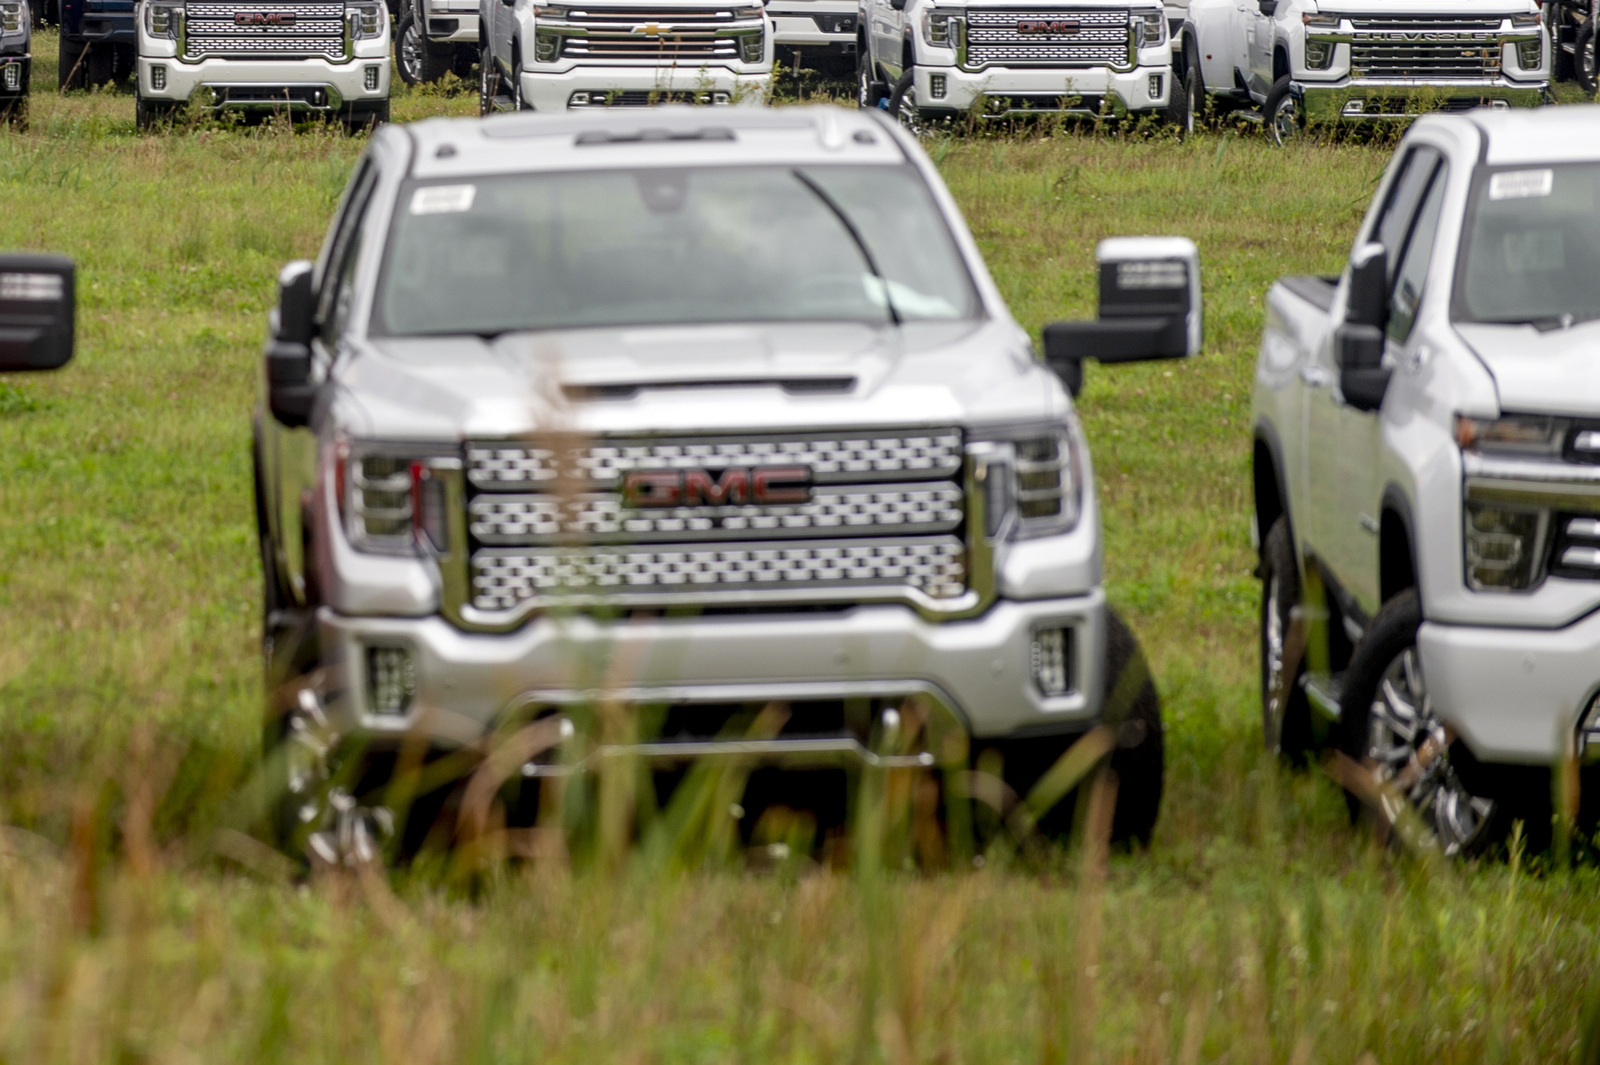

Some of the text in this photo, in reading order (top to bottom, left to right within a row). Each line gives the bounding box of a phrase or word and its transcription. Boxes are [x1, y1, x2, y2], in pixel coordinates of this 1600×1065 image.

[235, 13, 295, 25] GMC
[1018, 21, 1079, 33] GMC
[1352, 33, 1500, 41] CHEVROLET
[624, 467, 810, 508] GMC
